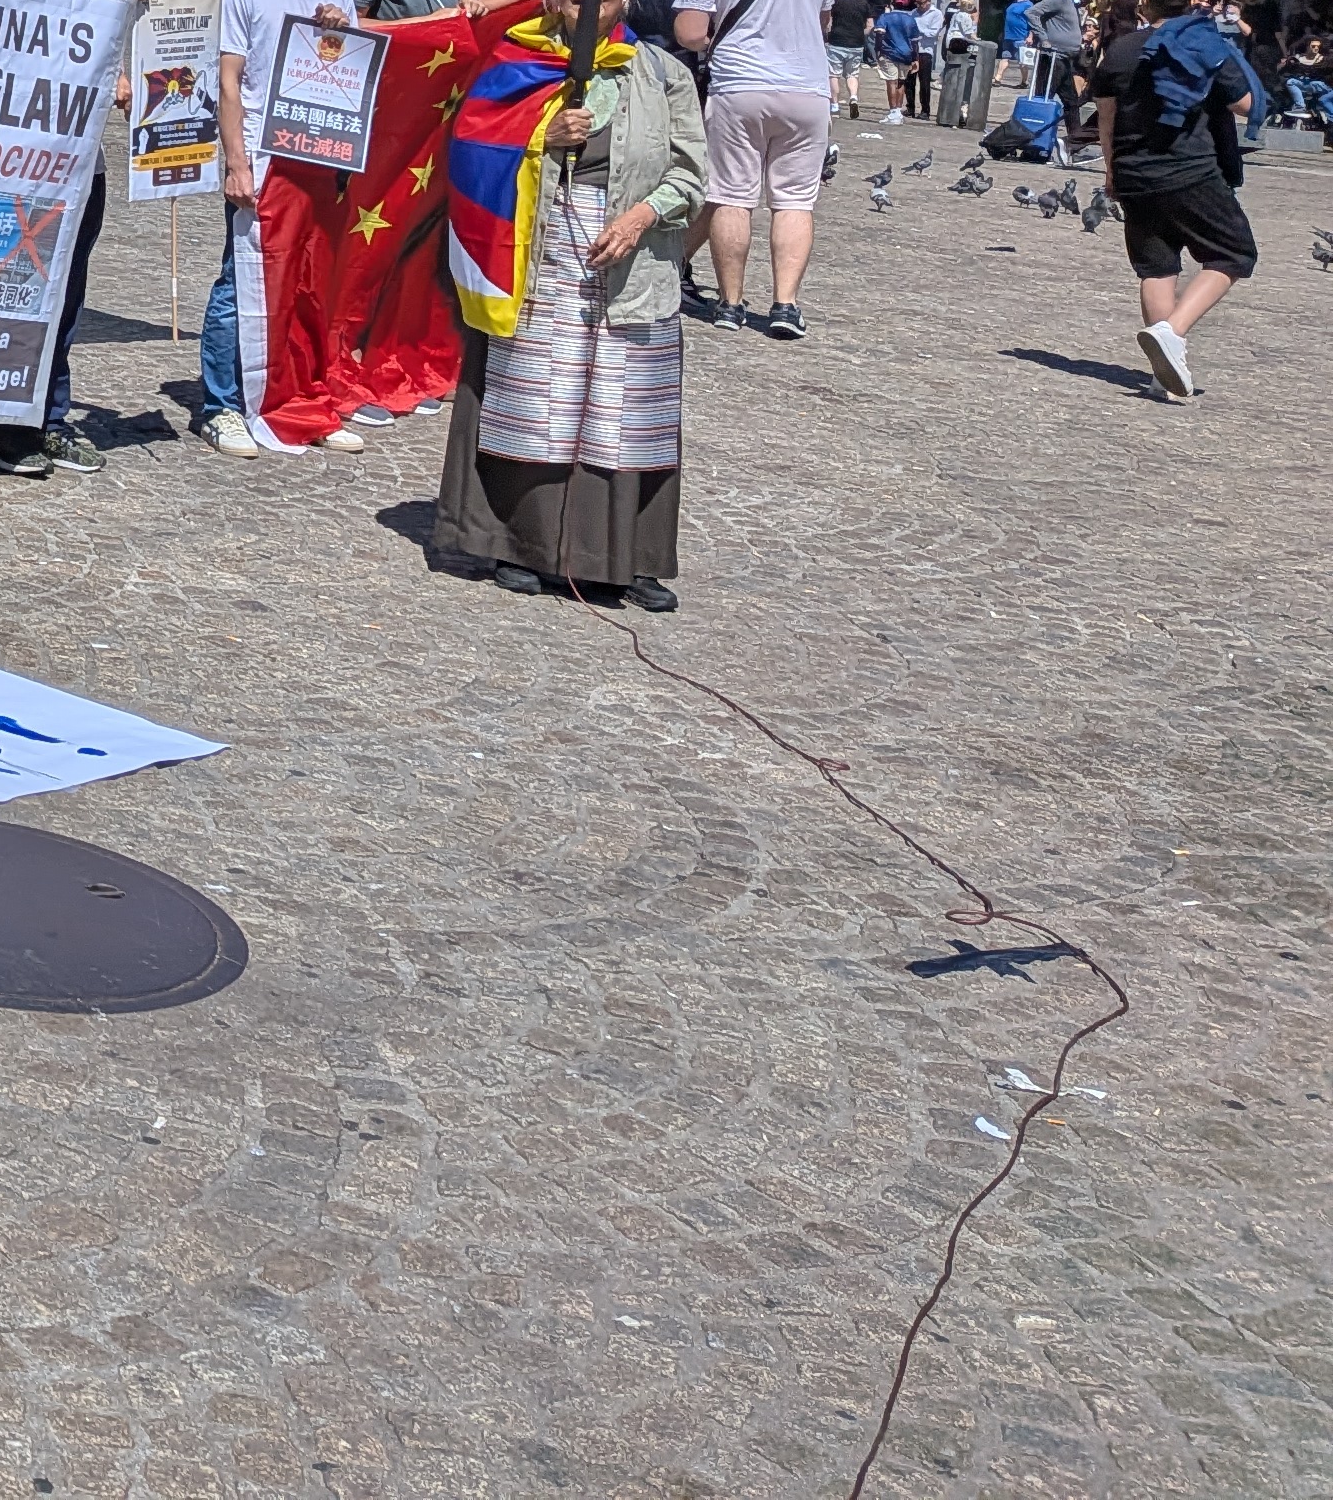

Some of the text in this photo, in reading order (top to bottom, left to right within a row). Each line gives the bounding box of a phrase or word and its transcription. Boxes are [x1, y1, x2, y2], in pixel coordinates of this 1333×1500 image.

[272, 100, 363, 135] 民族團結法
[272, 128, 353, 162] 文化滅絕
